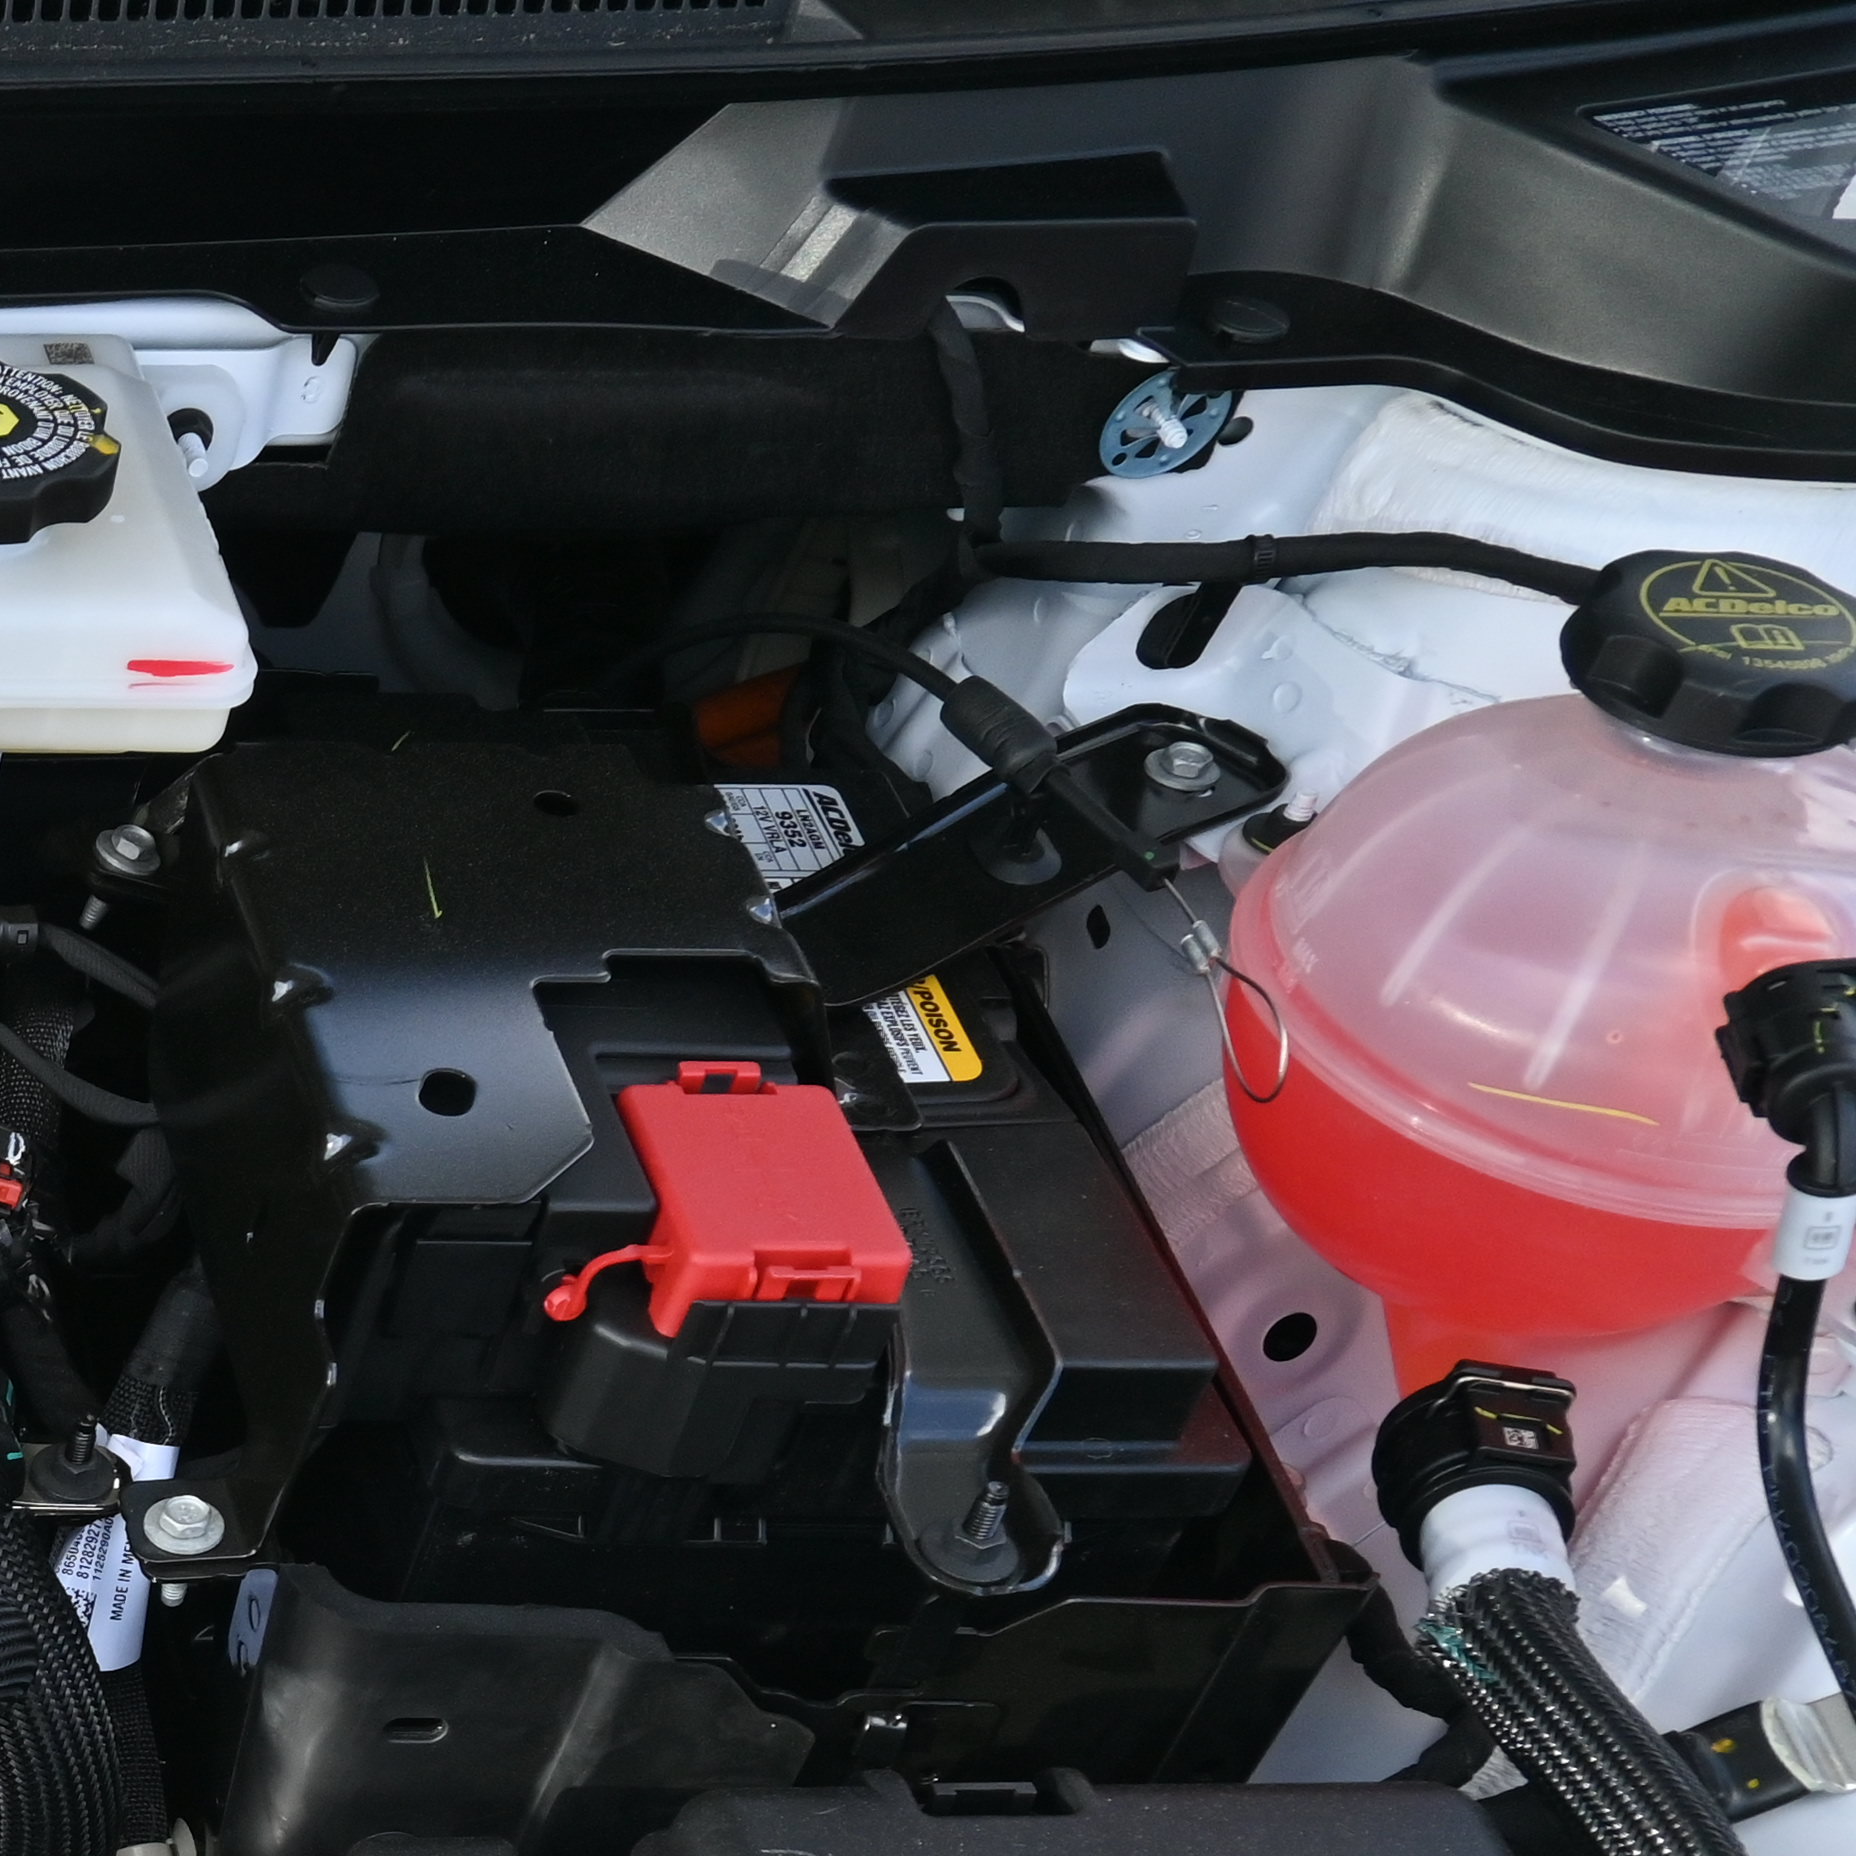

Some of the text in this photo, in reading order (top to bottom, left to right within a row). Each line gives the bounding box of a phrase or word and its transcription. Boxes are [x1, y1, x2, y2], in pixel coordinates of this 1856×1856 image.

[1, 464, 44, 480] AVANT
[1662, 596, 1840, 617] ACDelco
[752, 805, 788, 854] 12V VRLA
[774, 811, 808, 848] 9352
[795, 809, 826, 850] LN2AGM
[117, 1568, 133, 1583] IN
[109, 1585, 129, 1622] MADE
